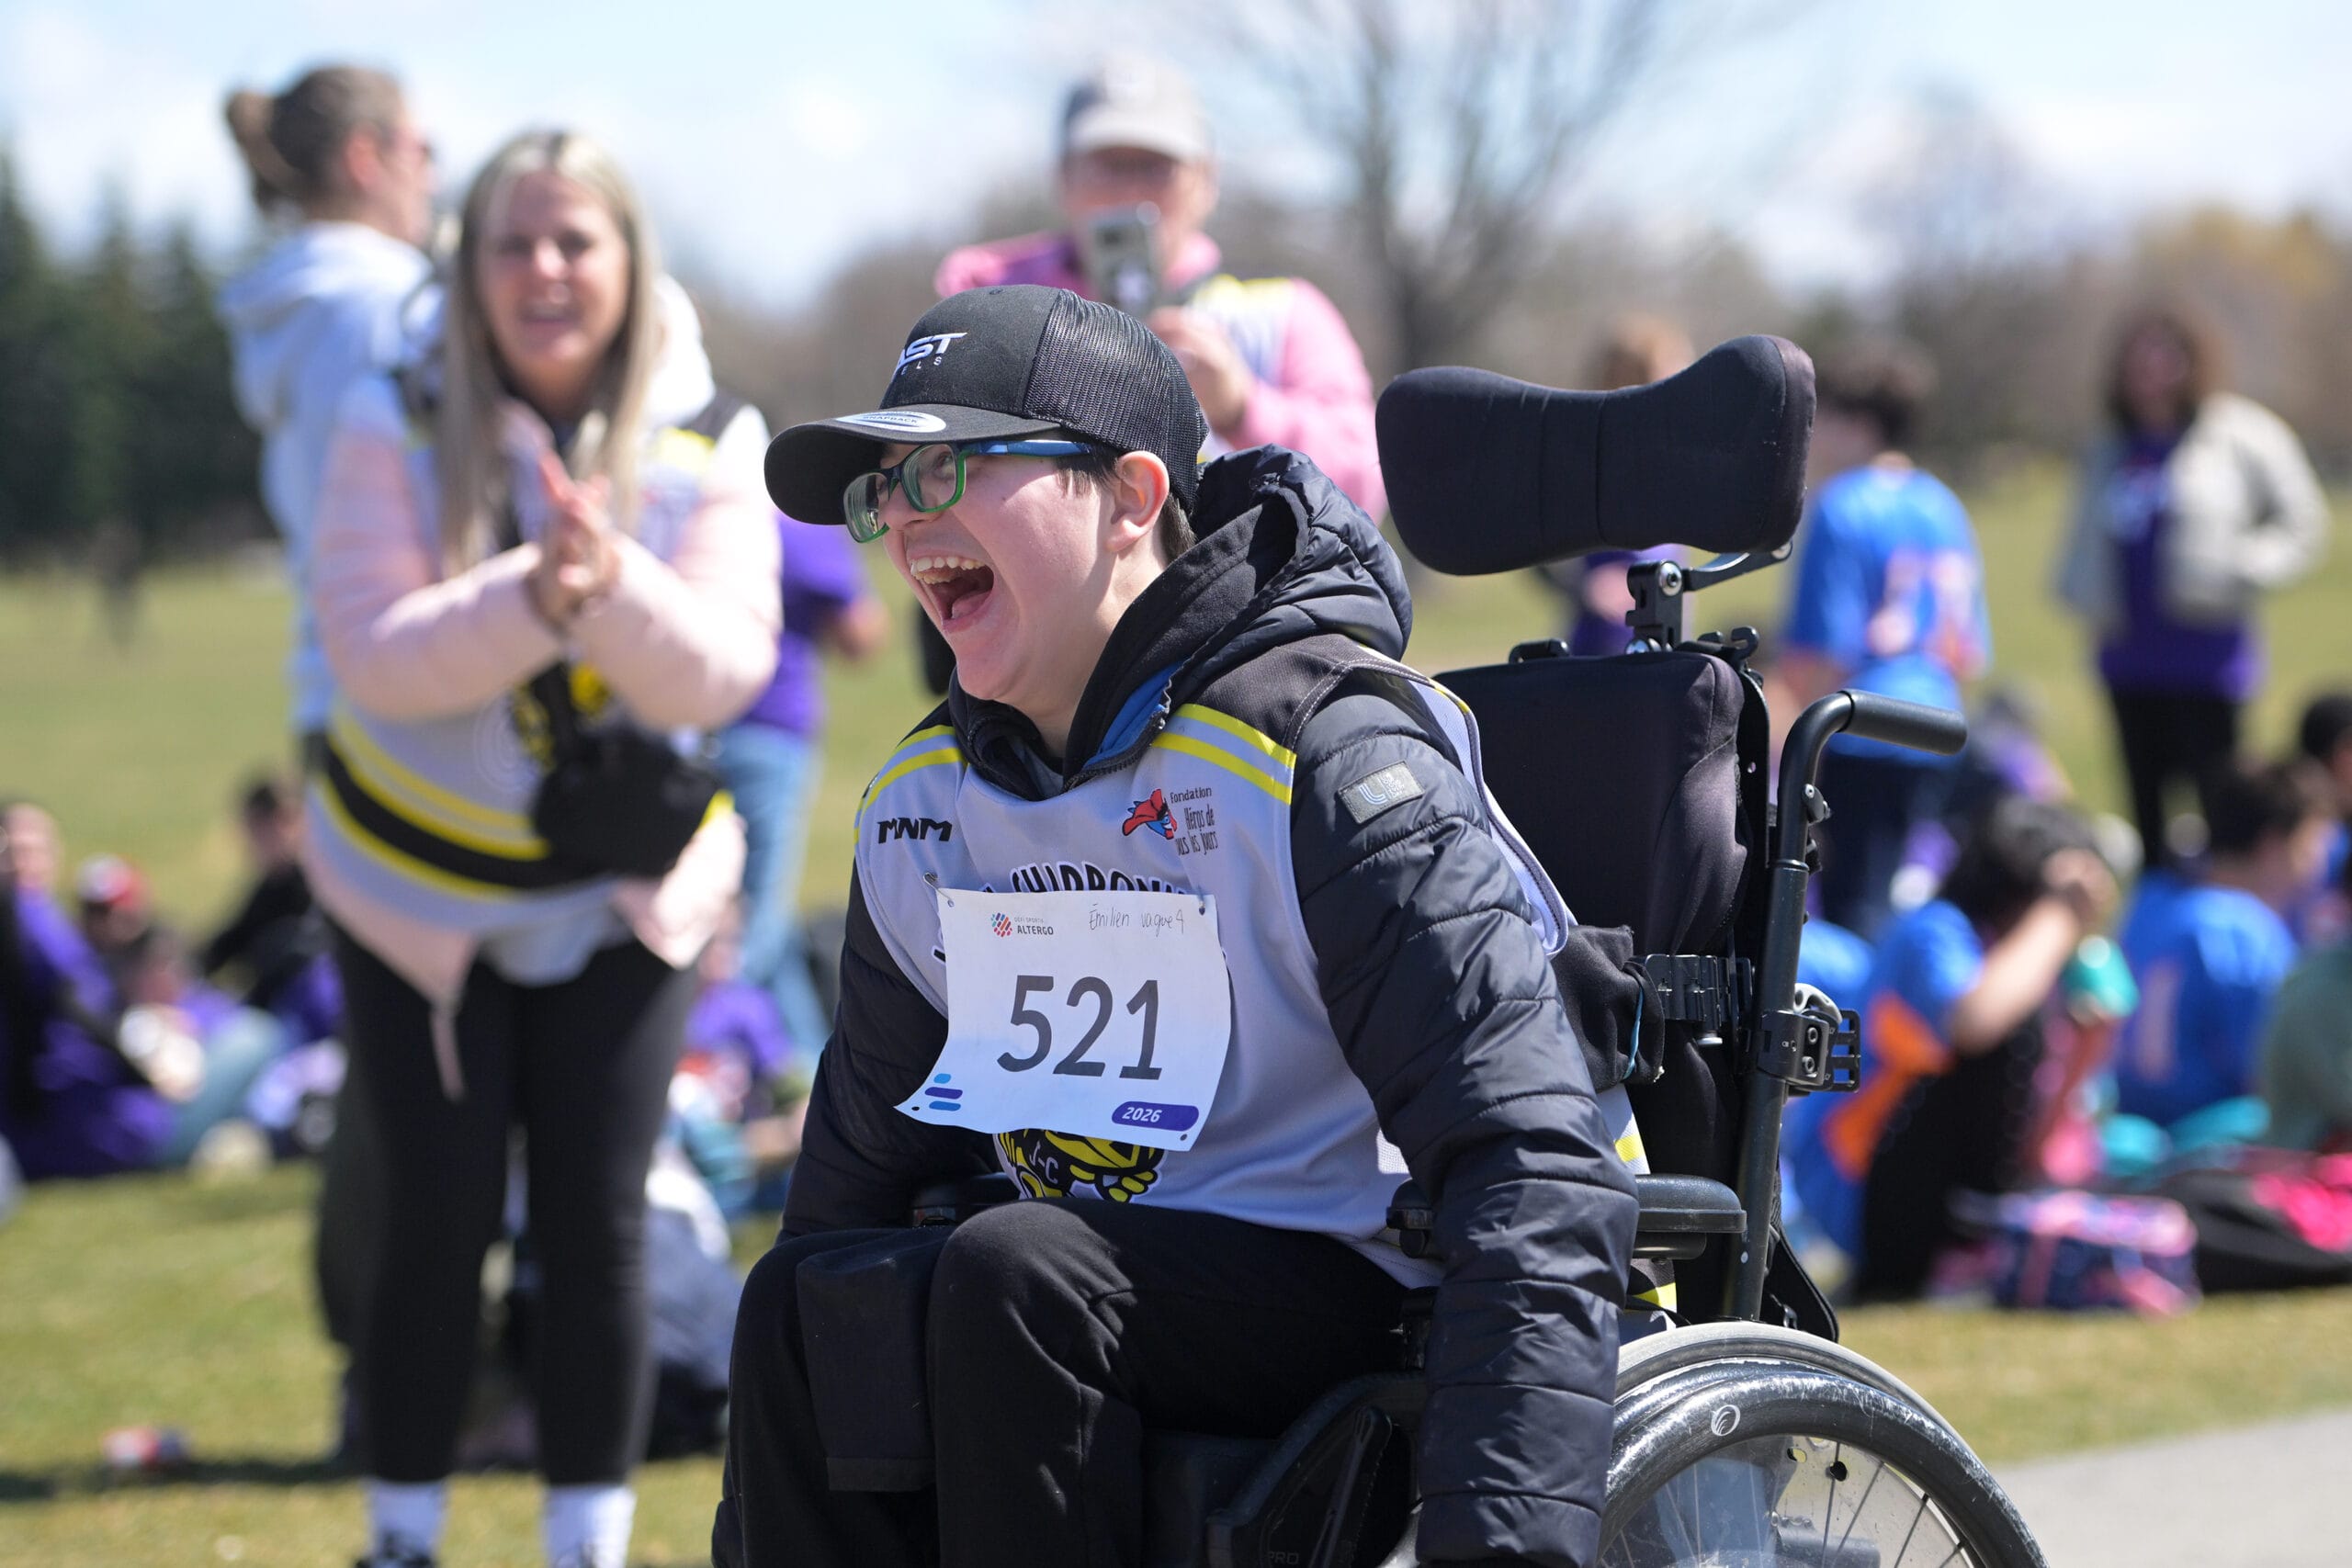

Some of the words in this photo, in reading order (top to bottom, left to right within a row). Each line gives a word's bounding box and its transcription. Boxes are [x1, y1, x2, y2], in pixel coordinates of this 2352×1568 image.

[1205, 803, 1216, 827] de
[877, 817, 953, 844] MNM
[1016, 924, 1055, 936] ALTERGO
[997, 975, 1163, 1081] 521
[1122, 1107, 1163, 1122] 2026
